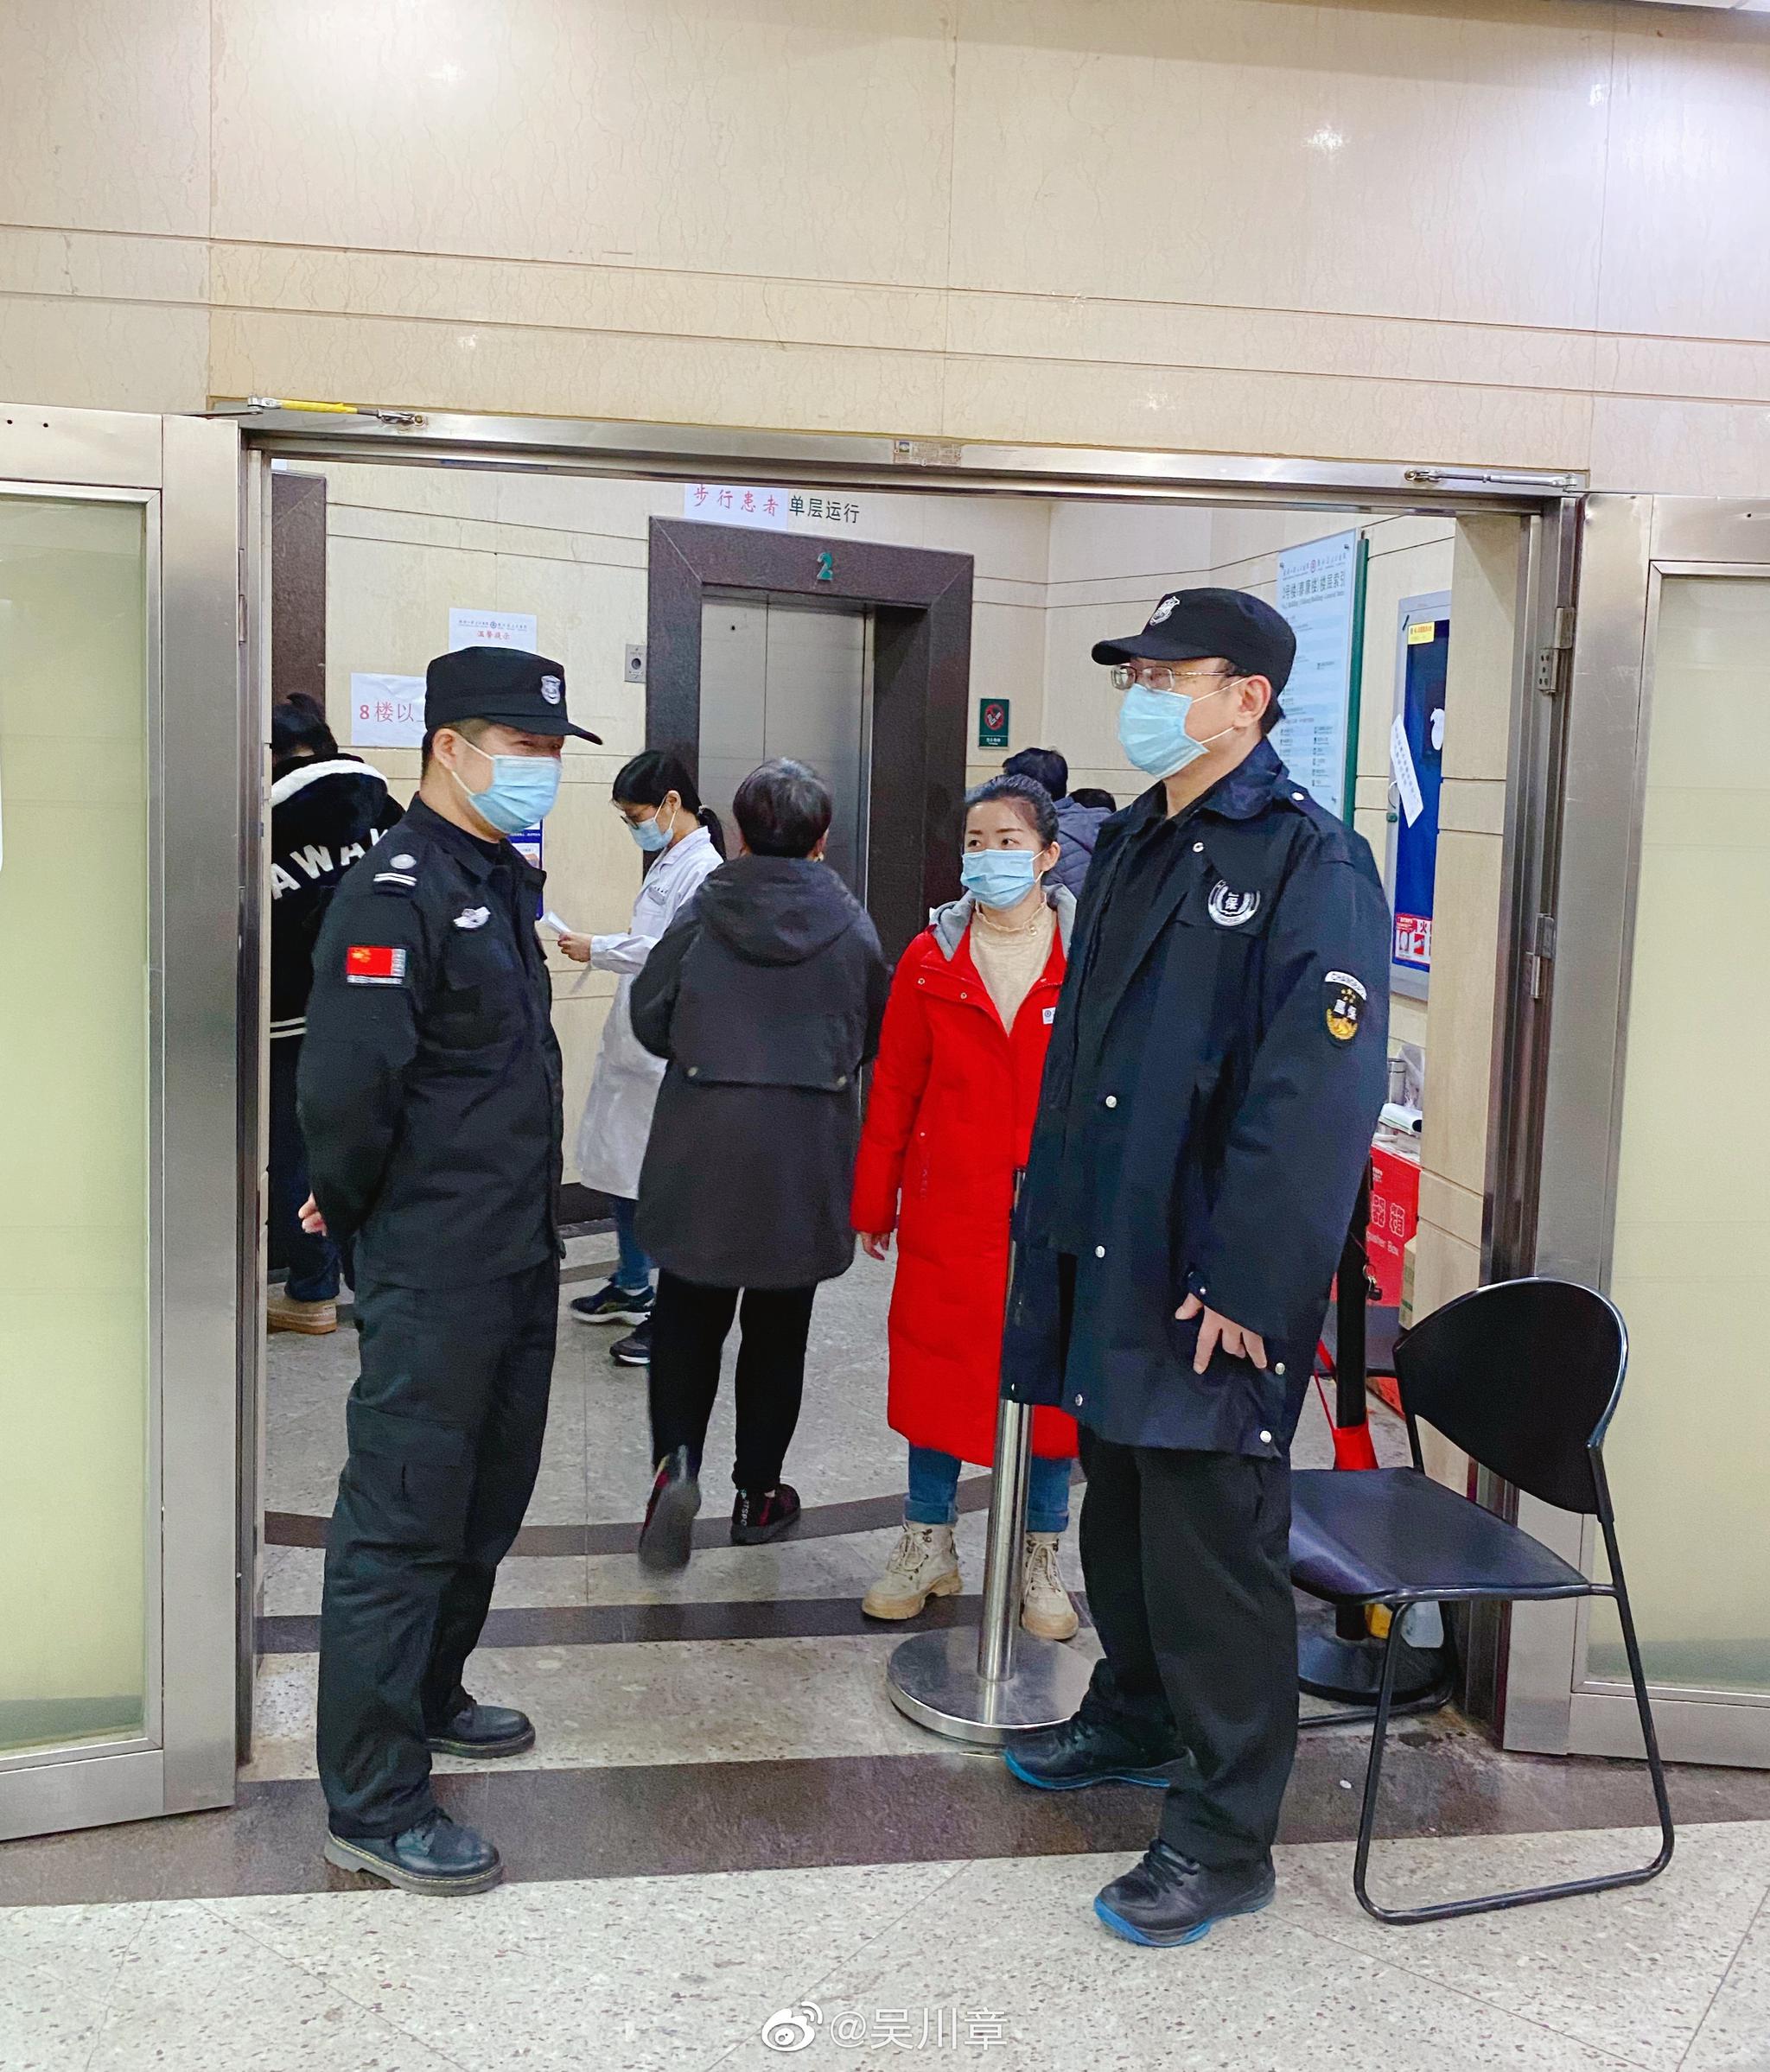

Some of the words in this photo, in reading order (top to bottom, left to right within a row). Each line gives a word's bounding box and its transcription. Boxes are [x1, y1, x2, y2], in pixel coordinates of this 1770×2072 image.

[694, 484, 779, 517] 步行患者
[789, 495, 860, 524] 单层运行
[817, 552, 834, 581] 2
